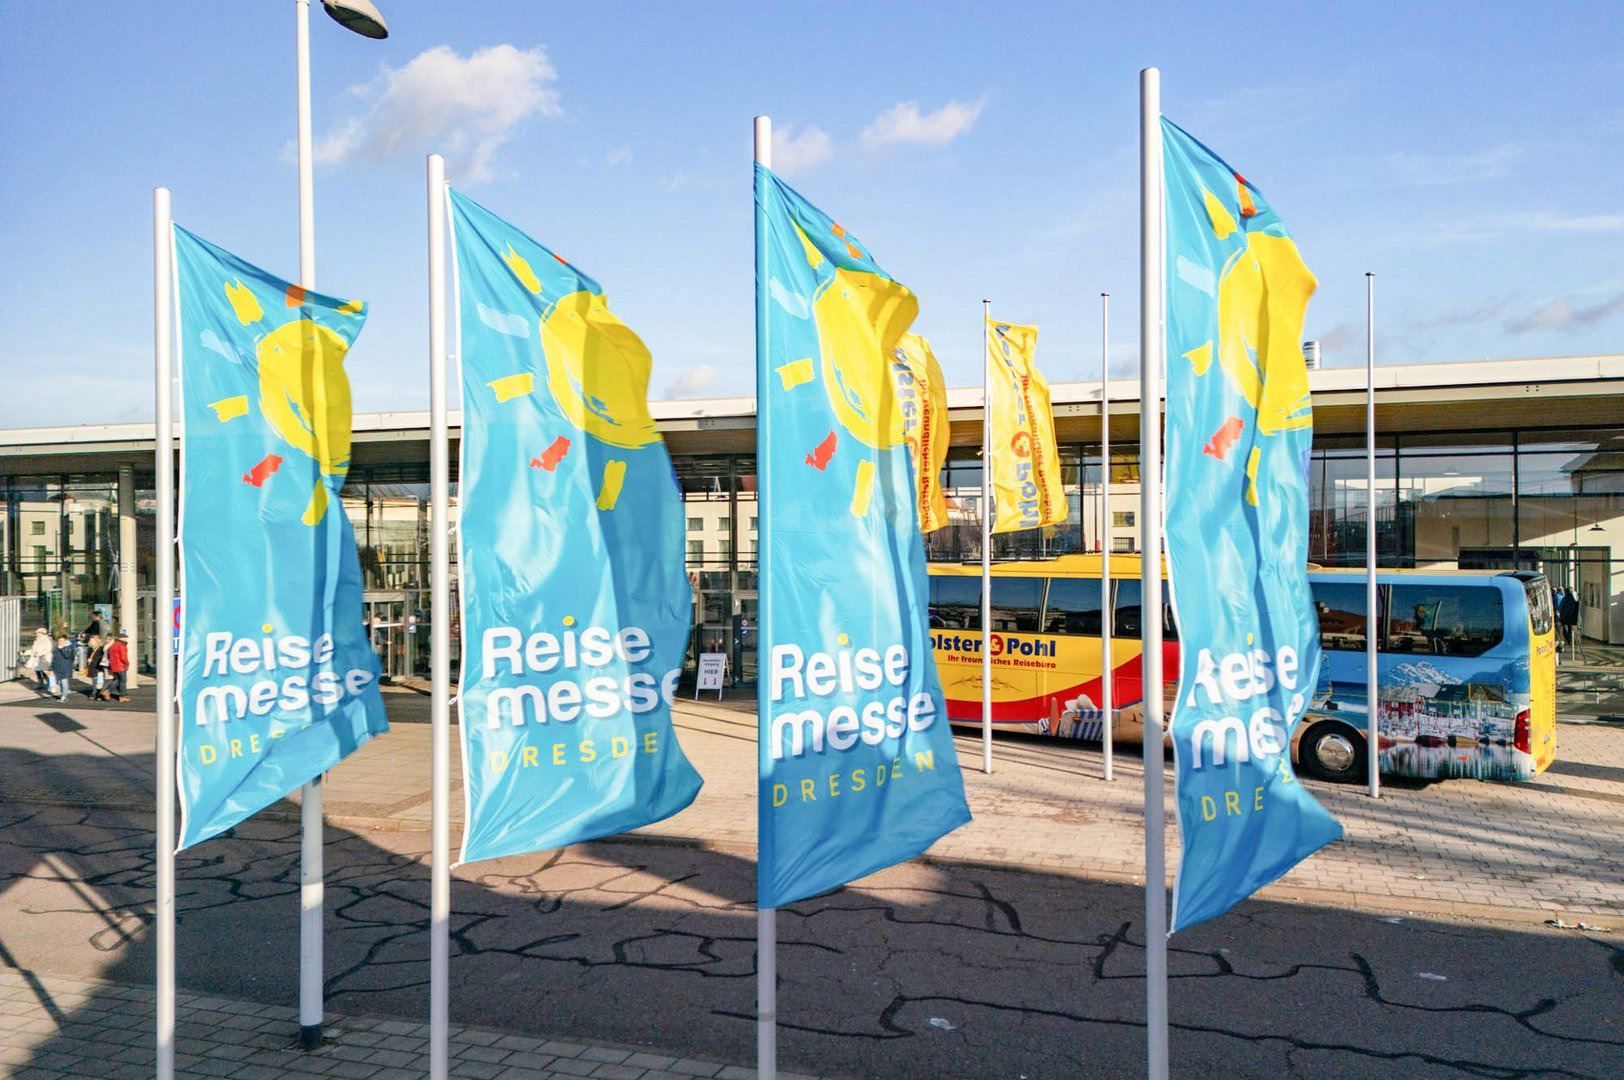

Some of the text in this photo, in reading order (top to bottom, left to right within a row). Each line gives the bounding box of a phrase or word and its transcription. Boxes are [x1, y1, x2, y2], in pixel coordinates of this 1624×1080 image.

[203, 624, 333, 678] Reise
[482, 616, 651, 679] Reise
[771, 633, 910, 701] Reise
[961, 655, 1011, 666] freuniches
[1006, 638, 1056, 657] Pohl
[196, 669, 375, 726] messe
[771, 693, 936, 759] messe
[772, 750, 935, 807] DRESDEN
